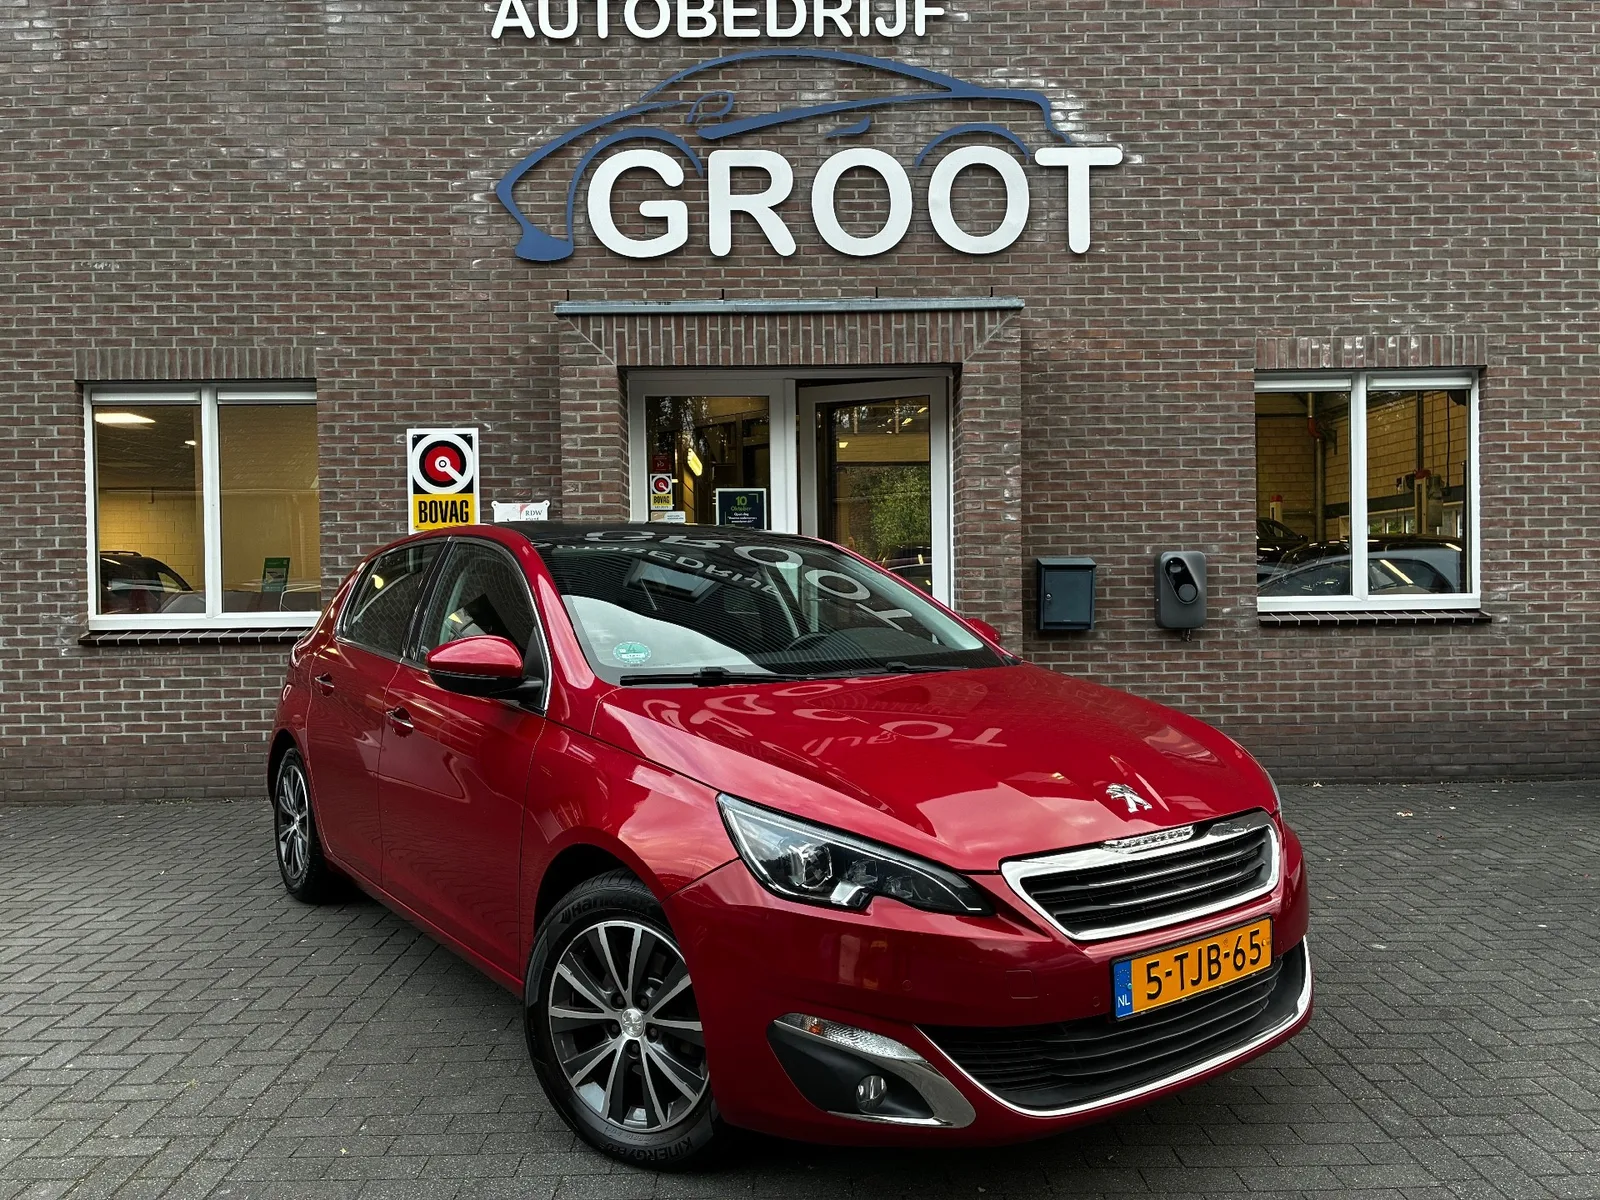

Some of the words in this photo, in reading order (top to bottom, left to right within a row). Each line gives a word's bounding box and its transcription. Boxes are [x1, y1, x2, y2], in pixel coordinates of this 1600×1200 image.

[491, 0, 945, 39] AUTOBEDRIJF
[586, 146, 1123, 258] GROOT
[653, 495, 670, 504] BOVAG
[735, 496, 748, 506] 10
[418, 500, 469, 524] BOVAG
[1146, 929, 1263, 1001] 5-TJB-65
[1117, 993, 1131, 1008] NL
